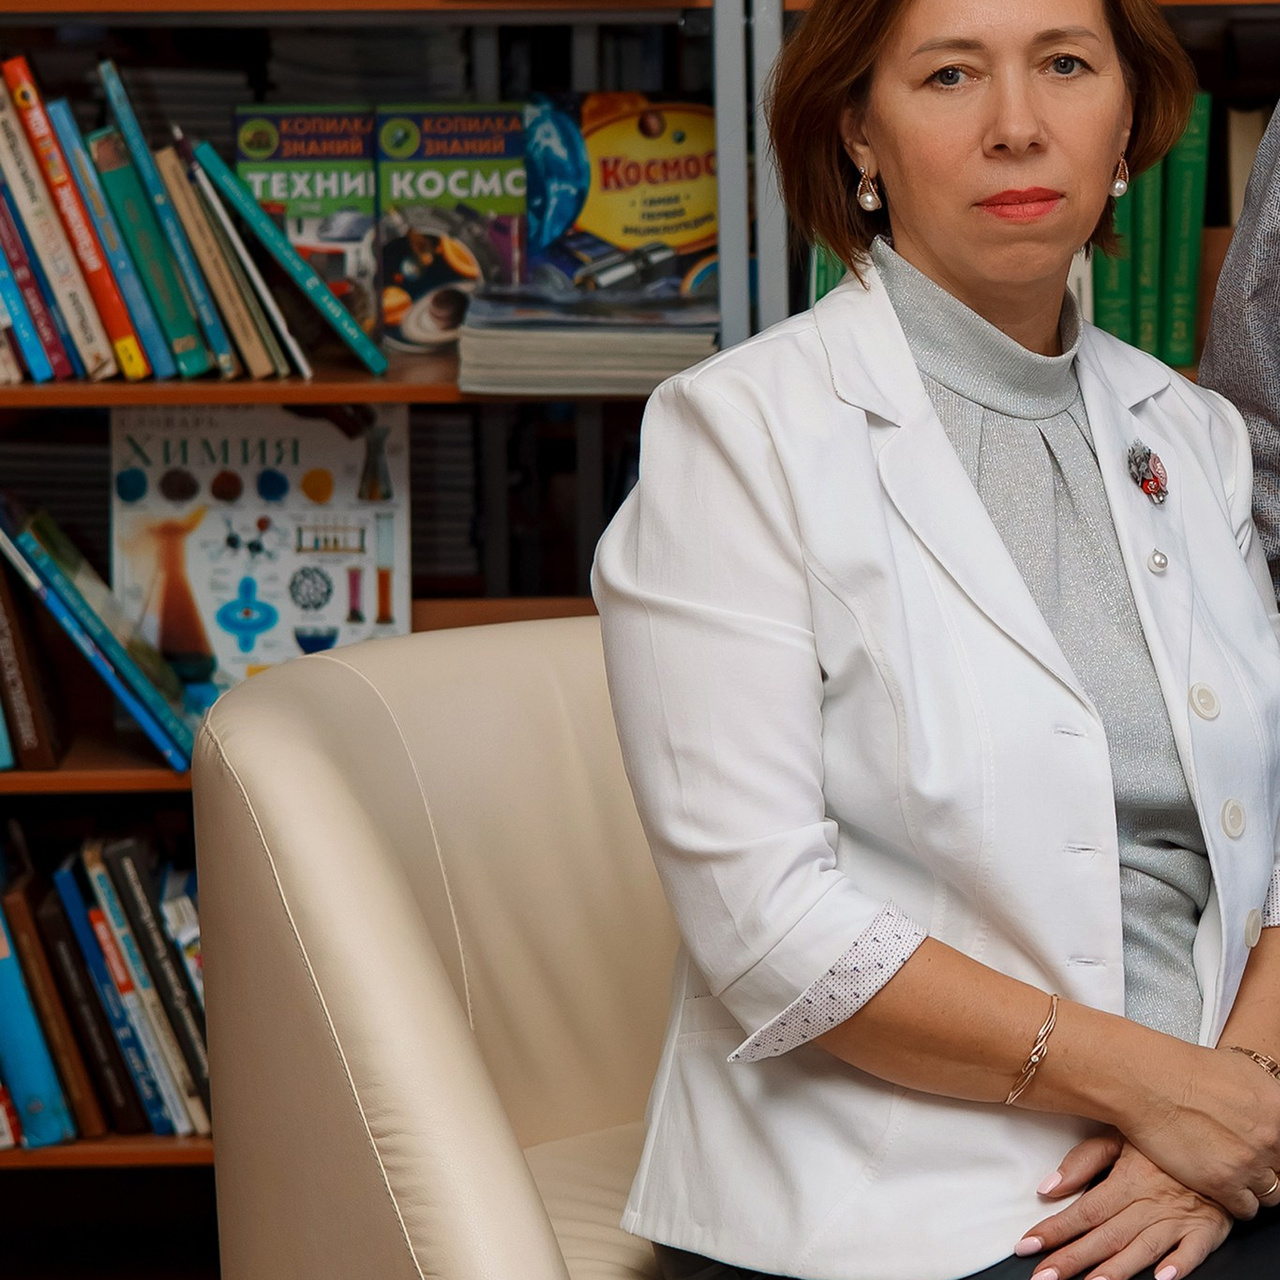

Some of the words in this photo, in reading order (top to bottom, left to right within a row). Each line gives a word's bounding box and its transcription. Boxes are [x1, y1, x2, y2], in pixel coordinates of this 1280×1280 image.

[423, 116, 521, 134] КОПИЛКА
[281, 137, 364, 157] ЗНАНИЙ
[424, 137, 505, 157] ЗНАНИЙ
[121, 434, 300, 467] ХИМИЯ
